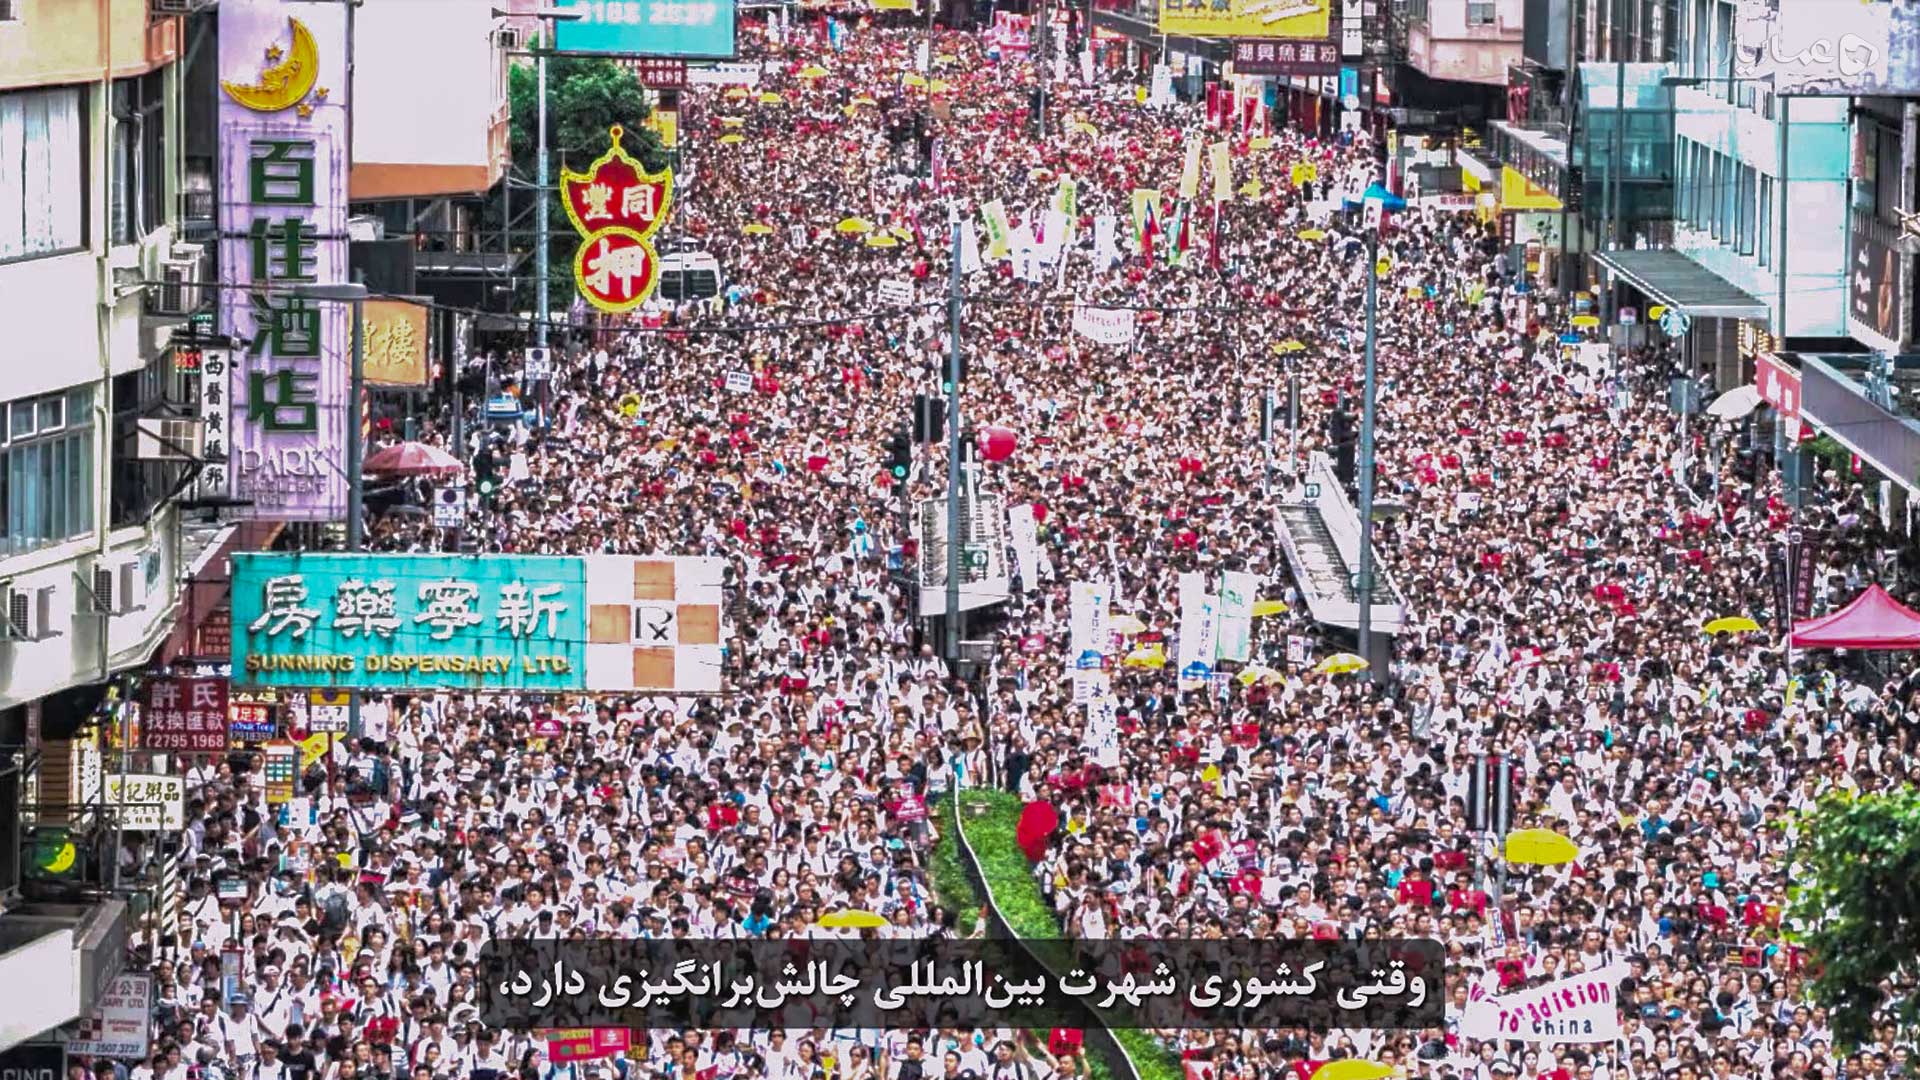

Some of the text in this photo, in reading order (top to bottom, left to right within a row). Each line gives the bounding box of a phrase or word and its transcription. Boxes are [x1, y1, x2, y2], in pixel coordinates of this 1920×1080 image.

[1236, 43, 1338, 63] 潮興魚蛋粉
[585, 237, 646, 299] 押
[249, 138, 322, 433] 百佳酒店
[237, 448, 328, 478] PARK
[245, 654, 572, 675] SUNNING DISPENSARY LTD.
[146, 710, 224, 732] 找換匯款
[192, 734, 224, 748] 1968
